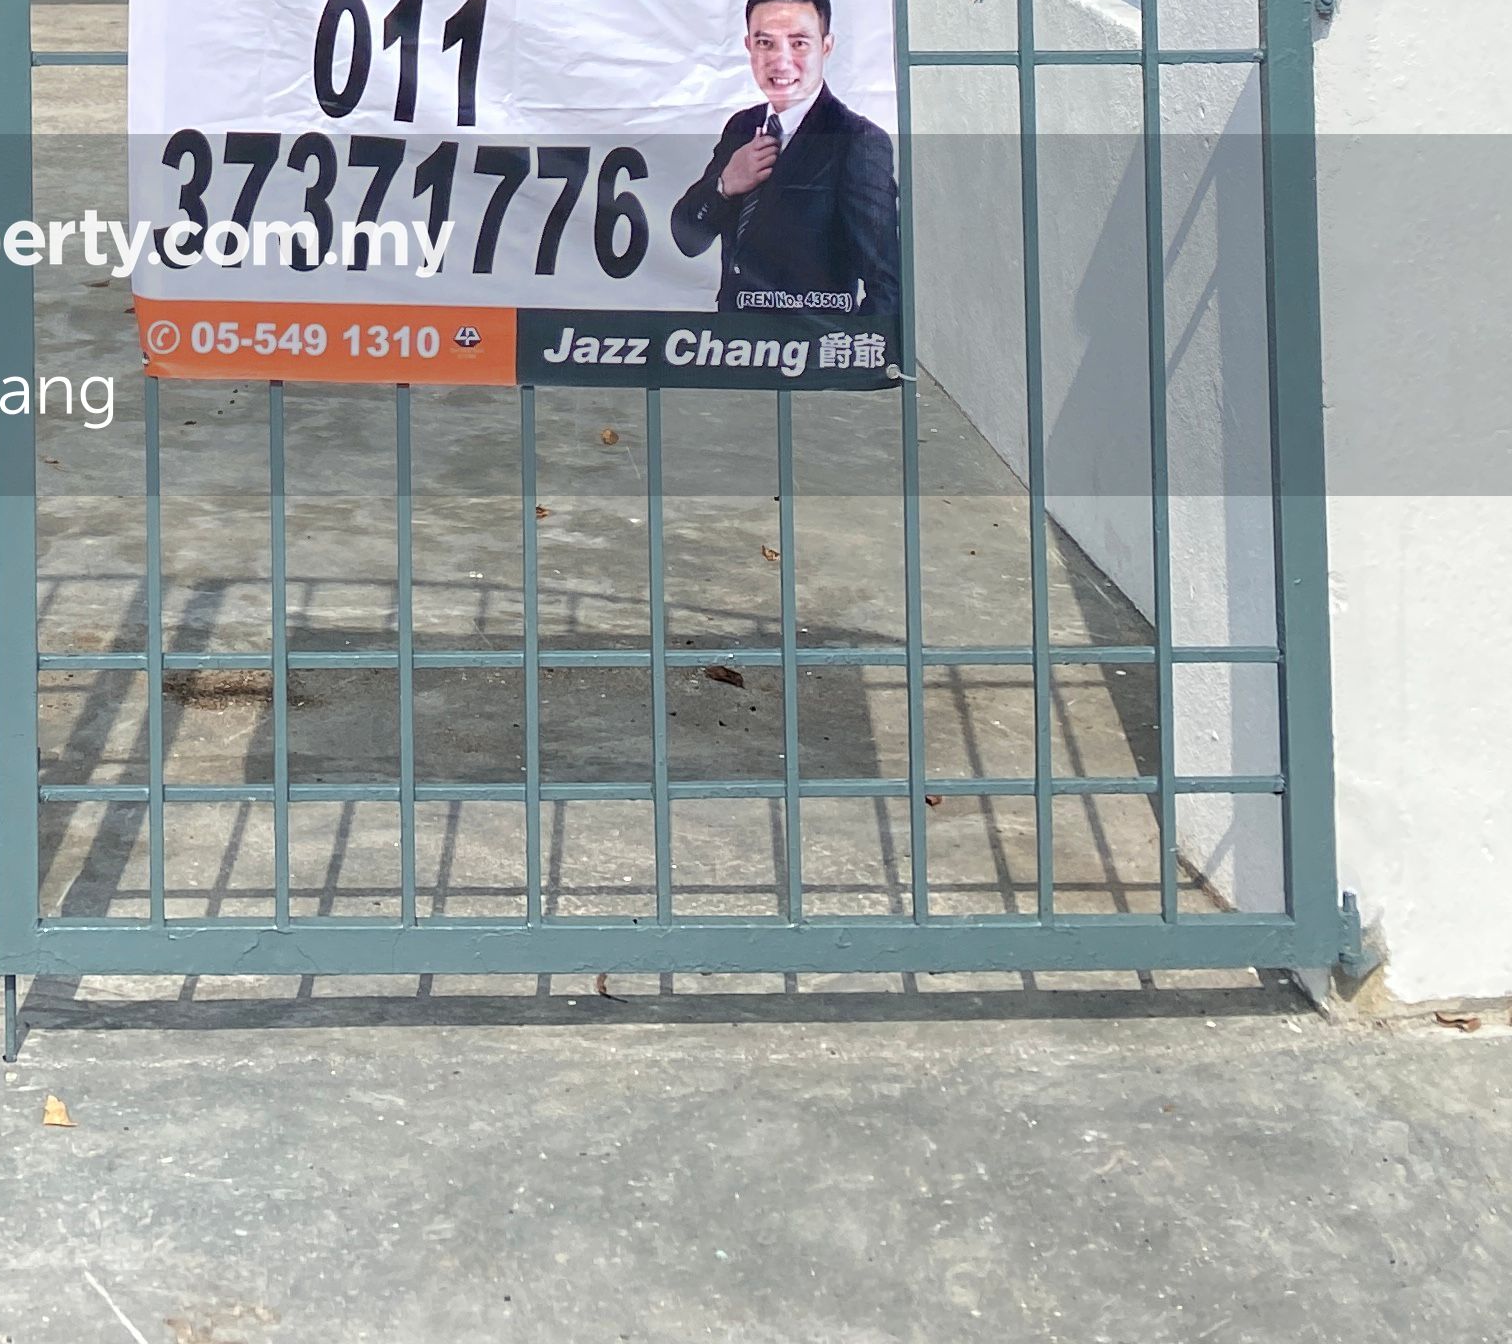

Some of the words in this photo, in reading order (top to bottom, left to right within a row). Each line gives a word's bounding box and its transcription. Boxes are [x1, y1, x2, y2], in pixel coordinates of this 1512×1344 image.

[156, 128, 650, 279] 37371776
[736, 291, 774, 309] (REN
[804, 291, 852, 313] 43503)
[190, 320, 328, 356] 05-549
[342, 324, 441, 359] 1310
[543, 327, 651, 365] Jazz
[664, 328, 811, 378] Chang
[819, 332, 886, 369] 爵爺
